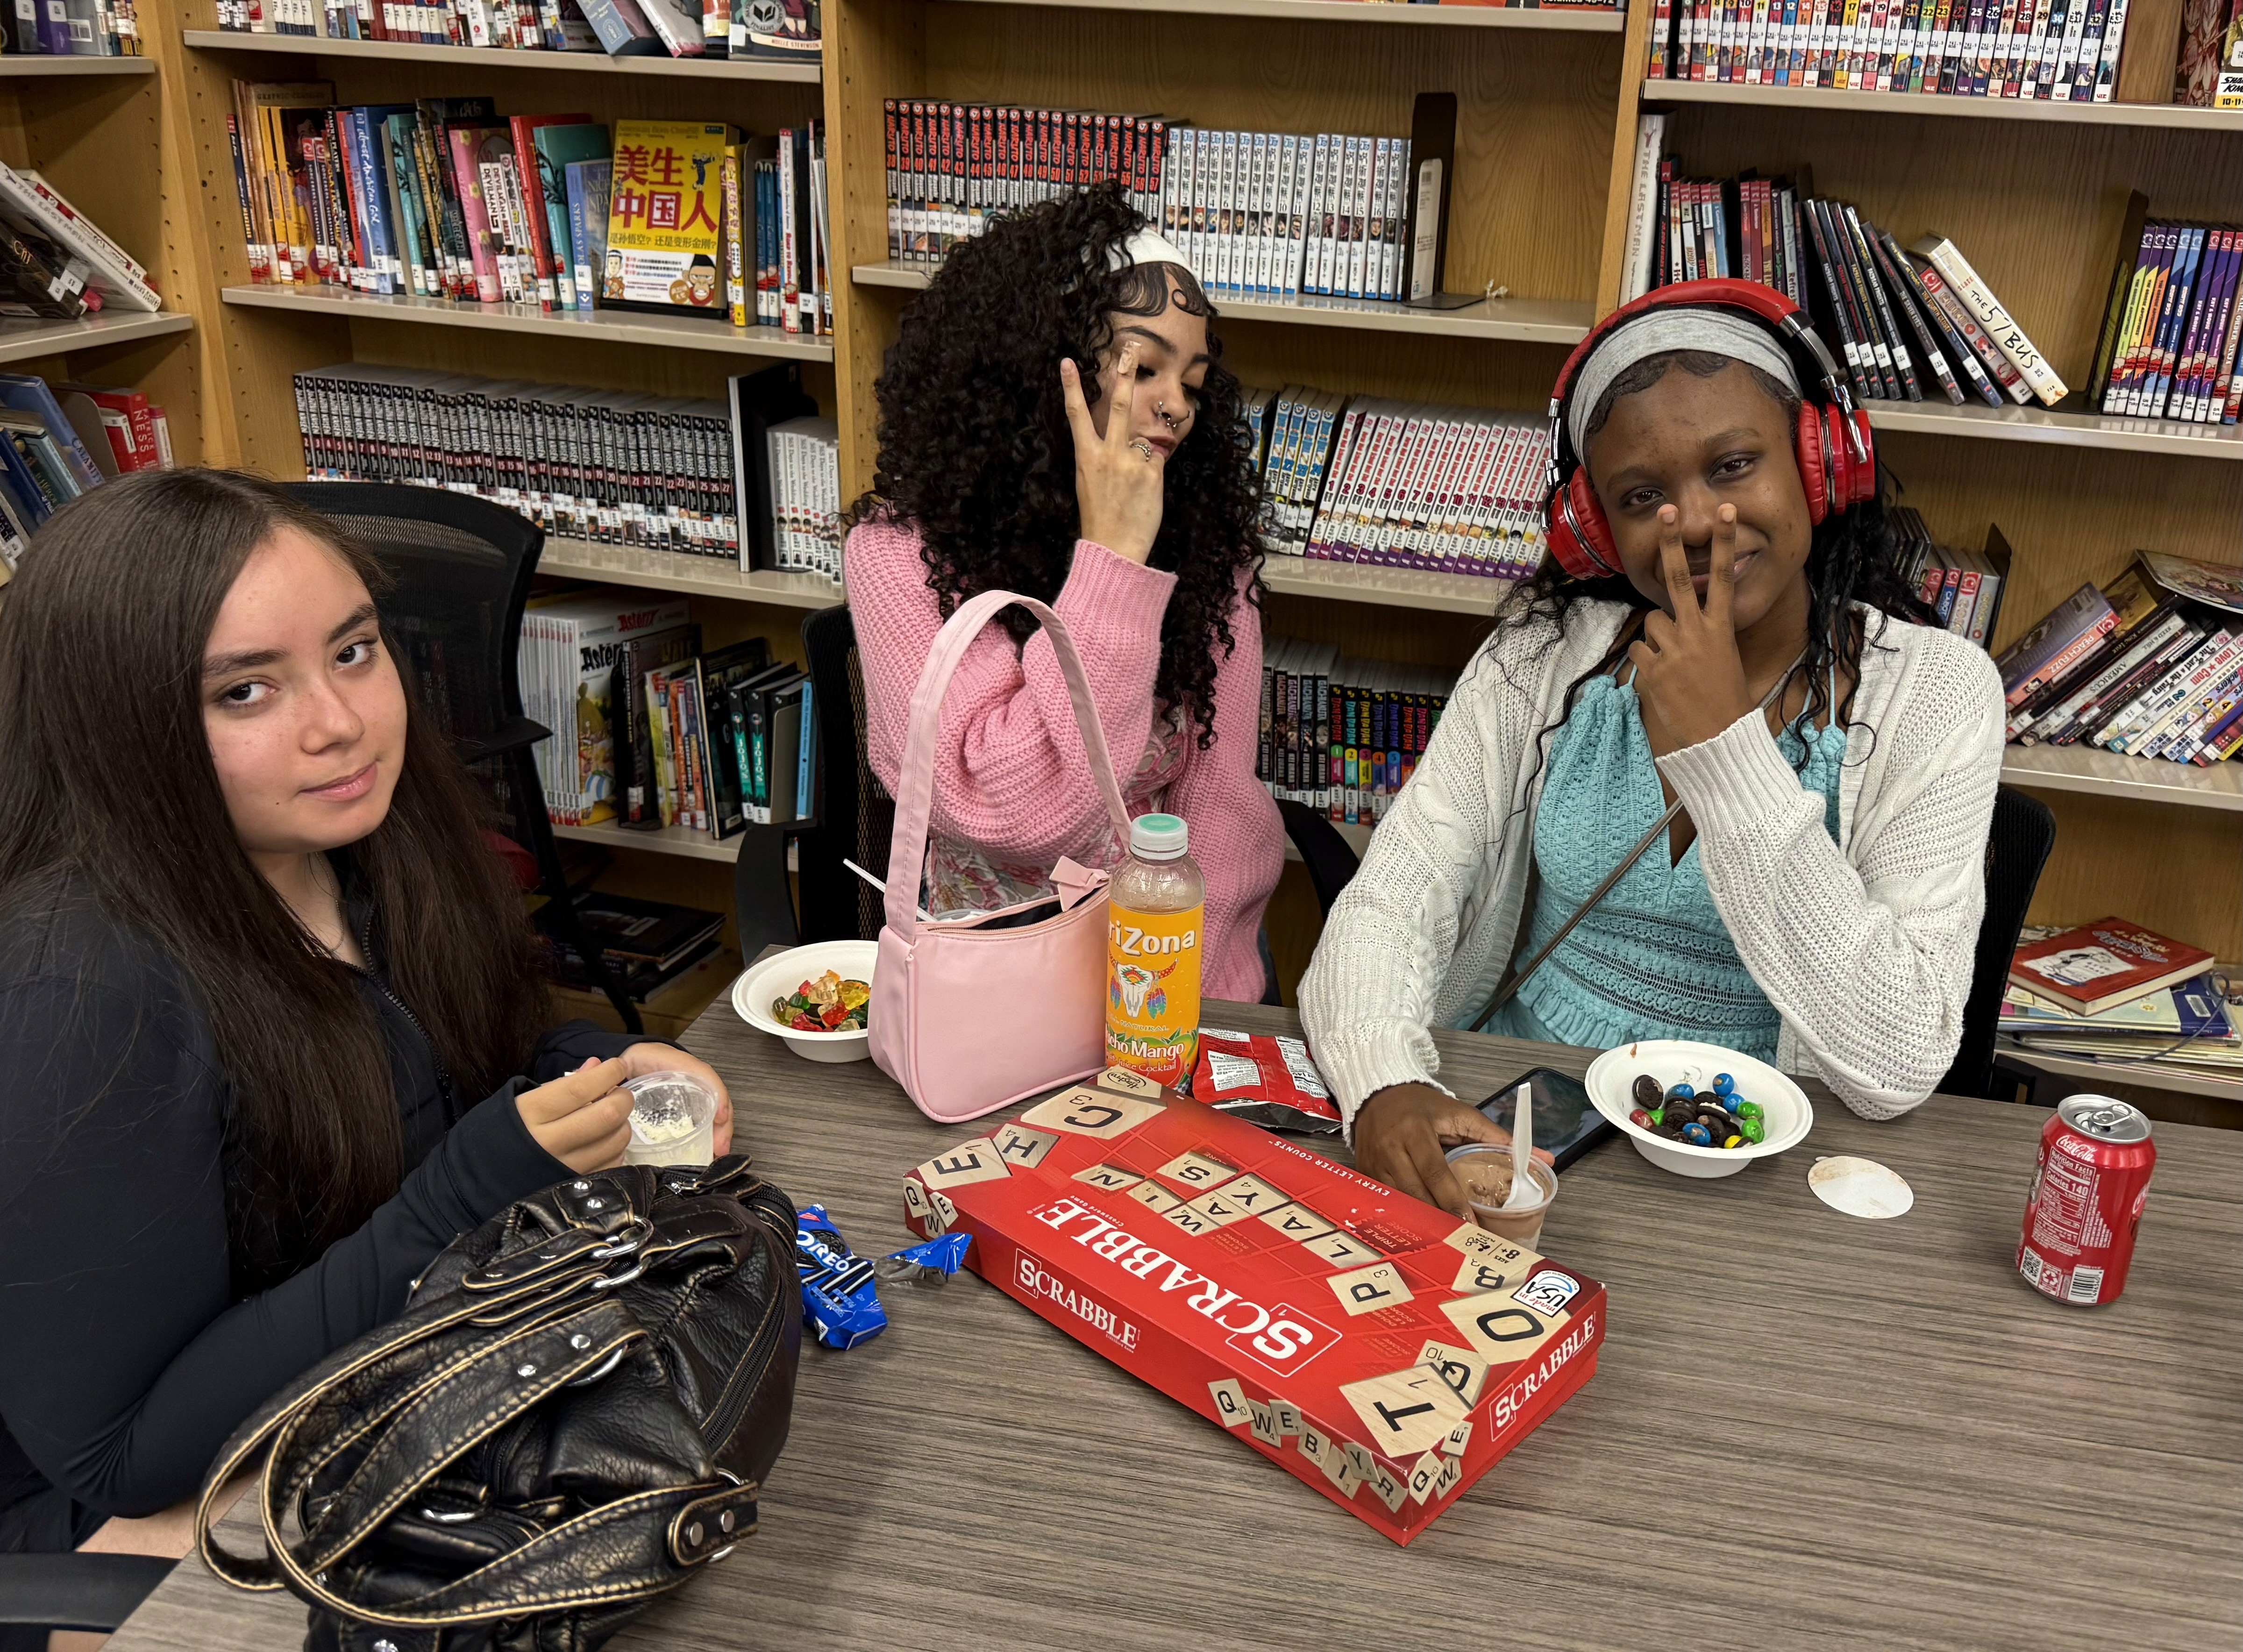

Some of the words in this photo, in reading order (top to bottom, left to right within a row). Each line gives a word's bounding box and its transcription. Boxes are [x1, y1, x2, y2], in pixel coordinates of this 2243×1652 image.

[1971, 7, 1982, 16] 25
[1988, 8, 1999, 16] 26
[2052, 14, 2064, 23] 30
[941, 119, 950, 156] NARUTO
[983, 123, 992, 160] NARUTO
[1011, 124, 1019, 162] NARUTO
[1053, 127, 1061, 164] NARUTO
[1081, 129, 1089, 167] NARUTO
[1124, 131, 1132, 169] NARUTO
[1152, 136, 1161, 175] NARUTO
[614, 144, 684, 187] 美生
[887, 155, 896, 168] 38
[941, 159, 950, 172] 42
[983, 163, 992, 177] 45
[1010, 165, 1018, 178] 47
[1641, 150, 1651, 178] THE
[1051, 167, 1060, 181] 50
[1079, 170, 1089, 183] 52
[1121, 172, 1131, 185] 55
[1150, 177, 1159, 192] 57
[484, 169, 498, 213] DEVILMAN
[1169, 195, 1172, 205] 1
[1182, 196, 1187, 205] 2
[612, 188, 718, 233] 中国人
[1252, 201, 1257, 209] 8
[1313, 203, 1321, 212] 12
[1636, 184, 1646, 222] LAST
[574, 202, 585, 237] SPARKS
[1632, 224, 1642, 256] MAN
[1970, 290, 1988, 309] THE
[1980, 306, 2012, 332] 57
[2004, 331, 2039, 369] BUS
[134, 410, 148, 452] NESS
[71, 437, 102, 484] CALAMITY
[1329, 480, 1335, 491] 1
[1356, 484, 1365, 495] 3
[1412, 490, 1421, 501] 7
[1495, 496, 1506, 509] 13
[1522, 499, 1533, 512] 15
[2068, 634, 2095, 658] PEACH
[2049, 656, 2069, 674] FUZZ
[2089, 661, 2127, 693] AMERICUS
[2172, 689, 2186, 701] 2
[1346, 701, 1356, 717] DAN
[1346, 719, 1356, 727] DA
[1346, 728, 1356, 745] DAN
[1109, 920, 1196, 956] riZona
[1107, 1033, 1129, 1054] ucho
[1131, 1040, 1184, 1061] Mango
[1118, 1057, 1136, 1070] Juice
[1139, 1060, 1177, 1072] Cocktail
[1315, 1160, 1353, 1179] LETTER
[2051, 1149, 2073, 1168] Nutrition
[2075, 1162, 2093, 1175] Facts
[1355, 1179, 1390, 1196] EVERY
[2047, 1170, 2069, 1189] Calories
[2072, 1183, 2088, 1196] 140
[1364, 1228, 1396, 1249] TRIPLE
[1374, 1224, 1412, 1246] LETTER
[1387, 1221, 1422, 1242] SCORE
[797, 1230, 850, 1272] OREO
[1034, 1199, 1313, 1360] SCRABBLE
[1020, 1259, 1137, 1349] SCRABBLE
[1527, 1281, 1566, 1308] USA
[1496, 1314, 1594, 1428] SCRABBLE
